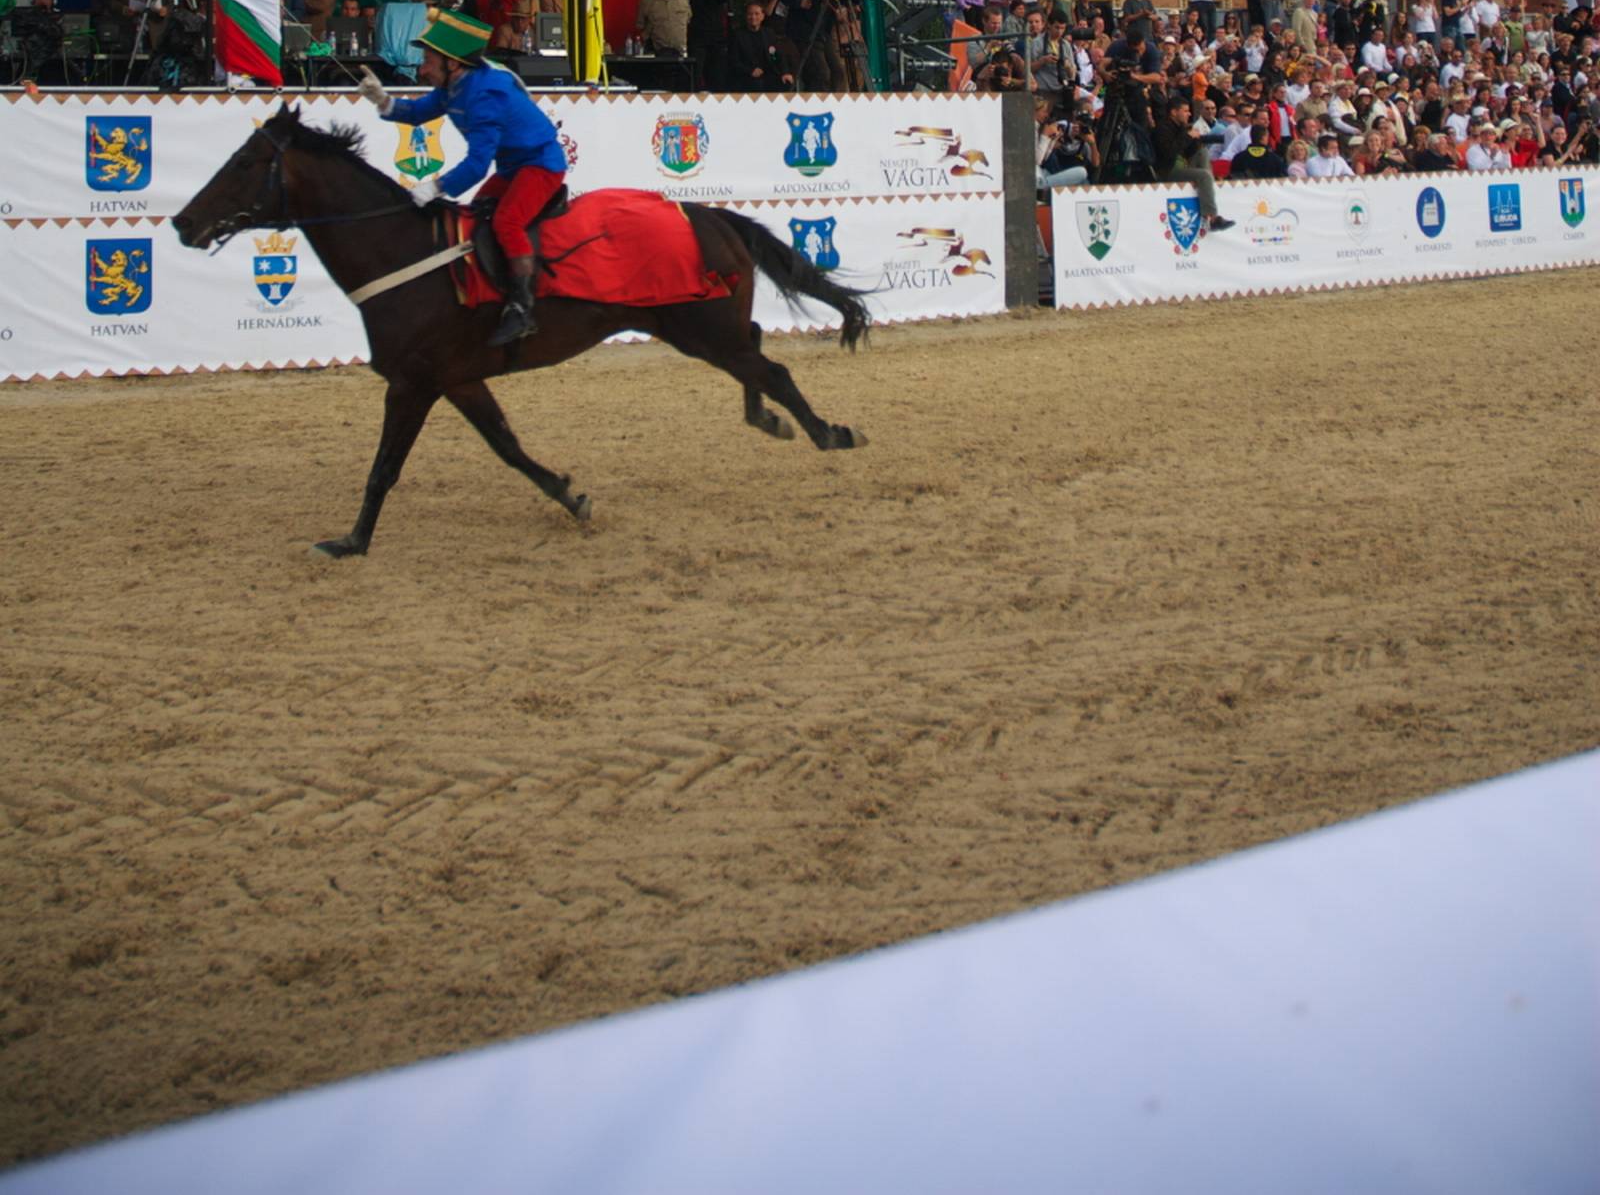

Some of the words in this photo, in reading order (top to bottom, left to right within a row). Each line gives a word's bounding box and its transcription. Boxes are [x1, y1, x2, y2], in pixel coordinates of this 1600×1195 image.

[90, 200, 148, 213] HATVAN
[237, 315, 323, 331] HERNÁDKAK
[90, 324, 148, 337] HATVAN
